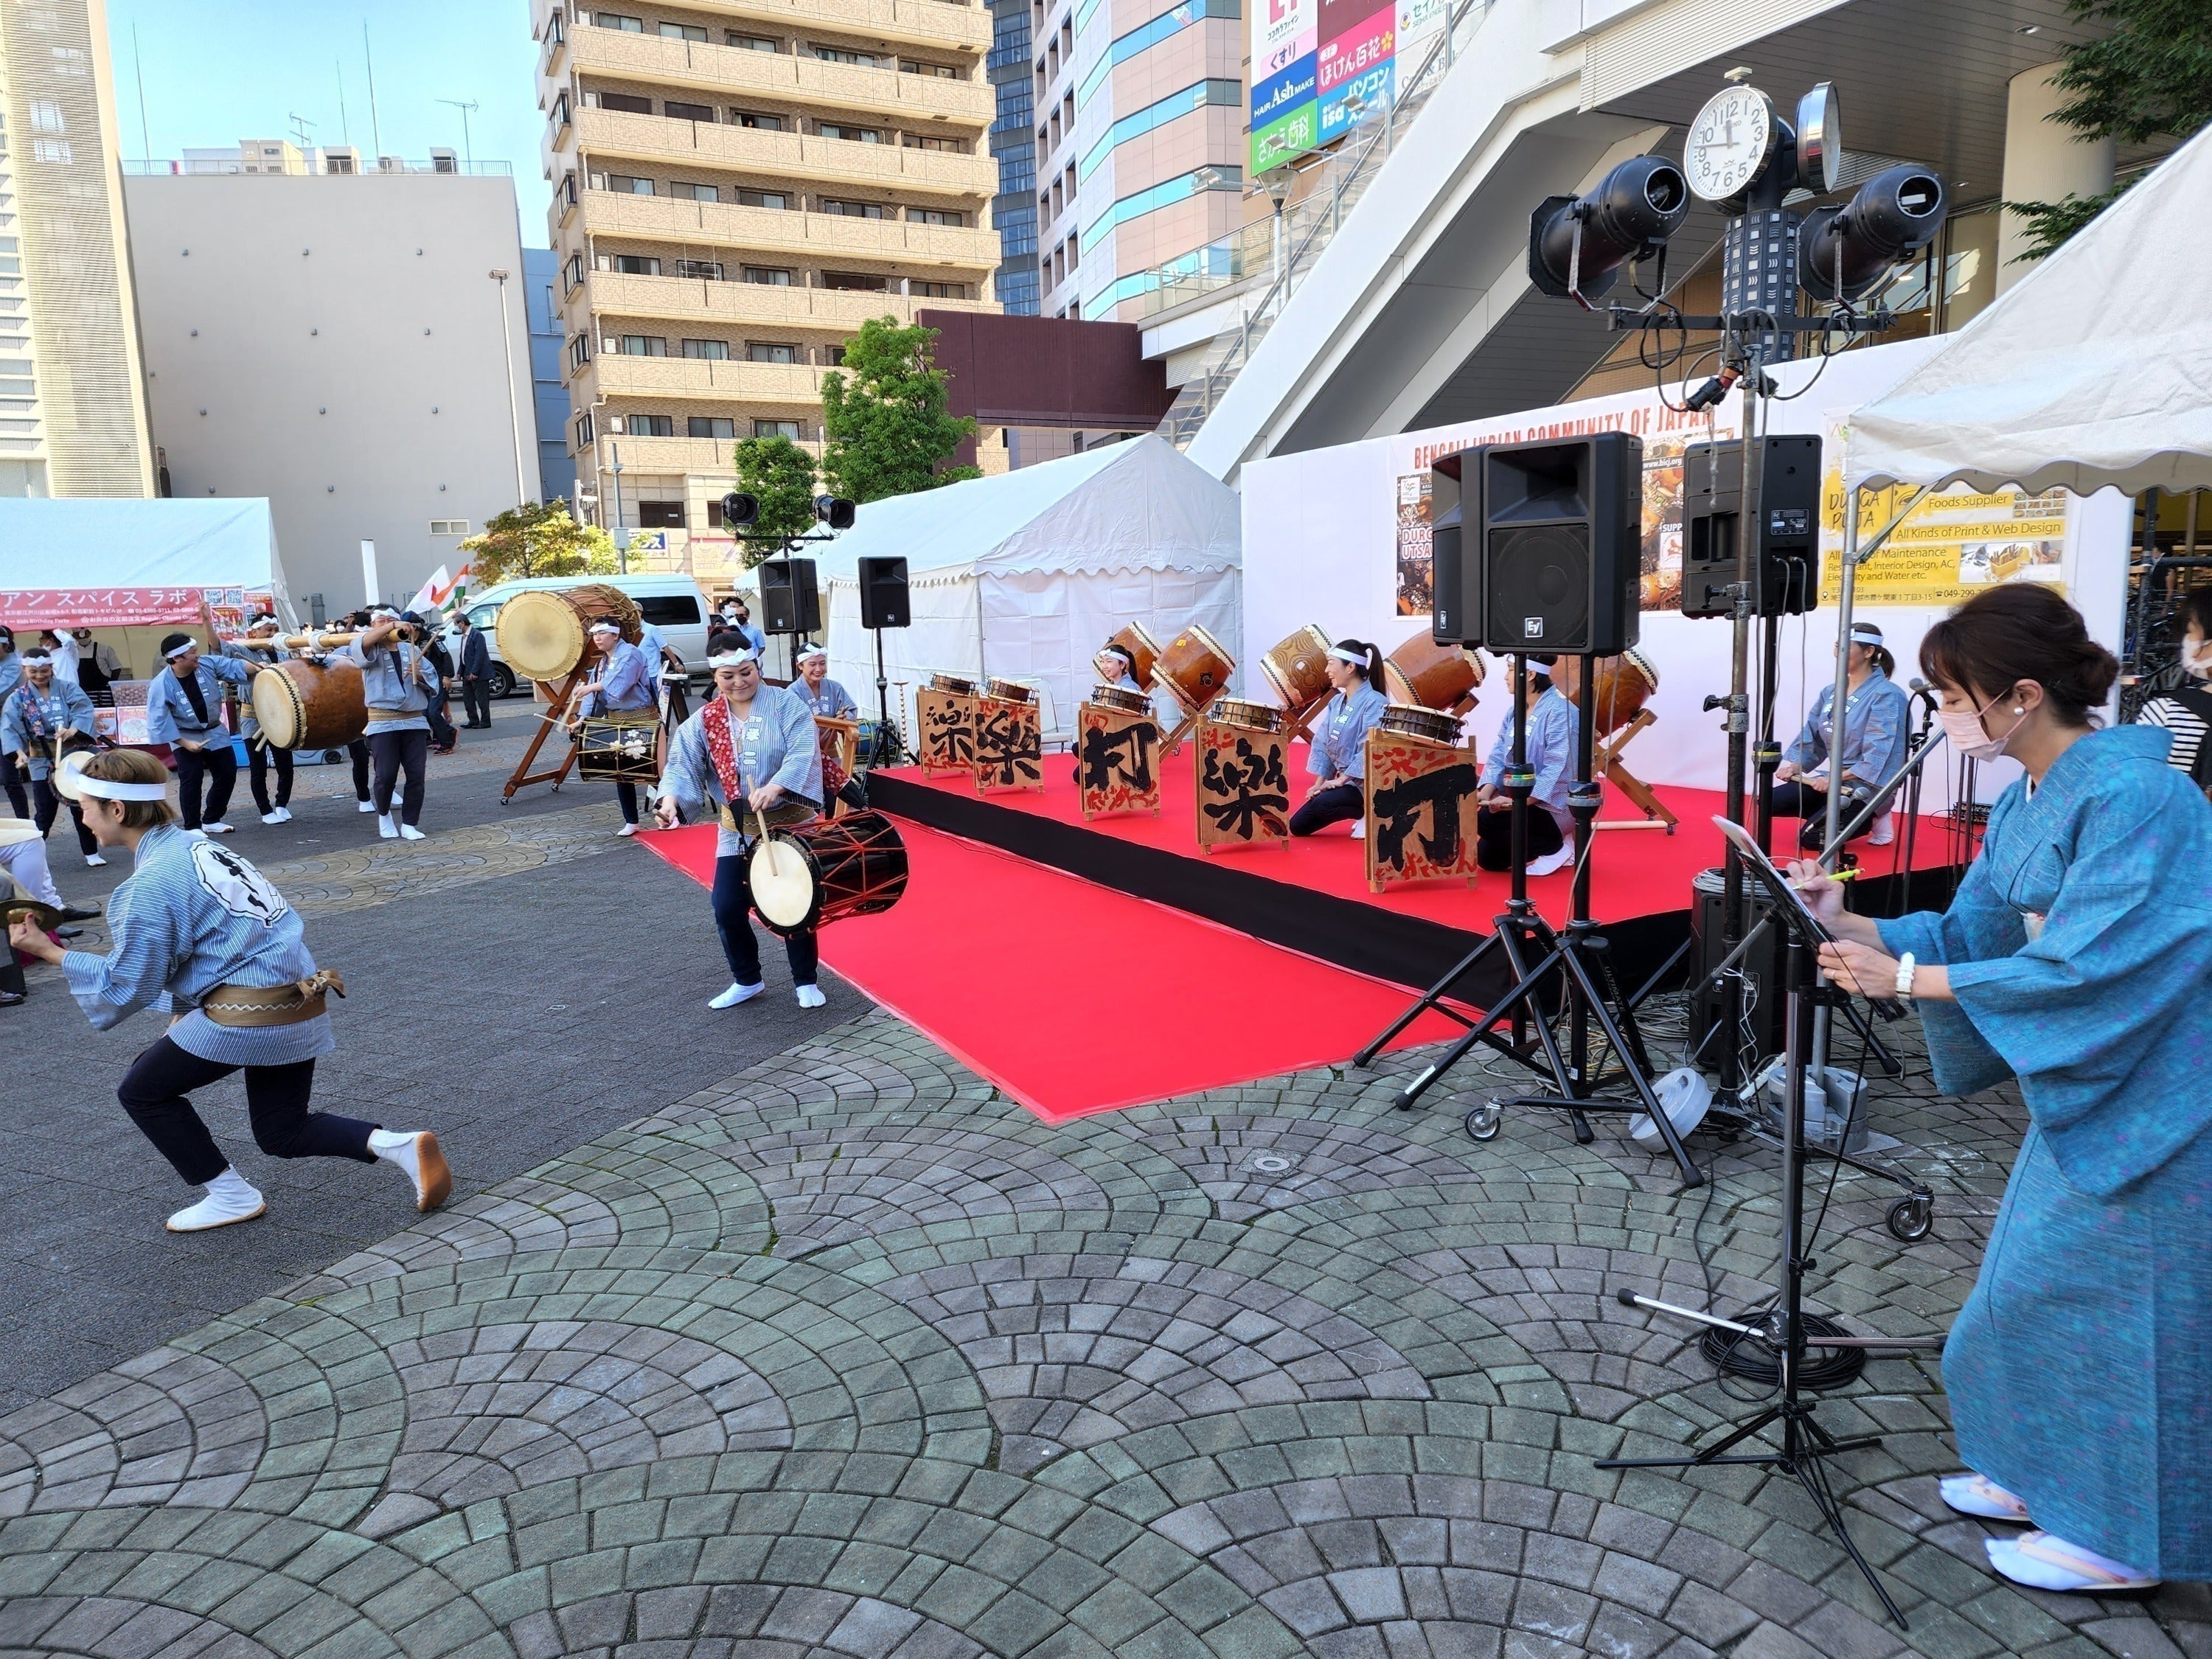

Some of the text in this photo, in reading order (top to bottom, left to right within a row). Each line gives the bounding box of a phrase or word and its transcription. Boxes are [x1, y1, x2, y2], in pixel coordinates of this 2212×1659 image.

[1270, 41, 1295, 70] くすり
[1321, 35, 1381, 86] ほけん百花
[1348, 66, 1390, 99] パソコン
[1254, 76, 1315, 118] HAIR Ash MAKE
[1322, 102, 1345, 130] isa
[1726, 100, 1739, 118] 12
[1750, 108, 1761, 125] 2
[1714, 109, 1723, 127] 11
[1702, 127, 1714, 144] 10
[1754, 125, 1764, 142] 3
[1698, 147, 1707, 163] 9
[1748, 145, 1759, 160] 4
[1703, 161, 1711, 177] 8
[1738, 161, 1747, 178] 5
[1711, 171, 1720, 187] 7
[1724, 170, 1733, 187] 6
[1527, 411, 1624, 442] COMMUNITY
[1630, 407, 1651, 437] OF
[1929, 494, 2008, 510] Foods Supplier
[1896, 522, 2061, 540] All Kinds of Print & Web Design
[1829, 548, 1947, 560] All of Maintenance
[1829, 559, 1956, 571] Resant, Interior Design, AC,
[1867, 572, 1882, 581] and
[1885, 571, 1910, 580] Water
[1912, 571, 1927, 580] etc.
[57, 590, 139, 608] スパイス
[150, 589, 188, 605] ラボ
